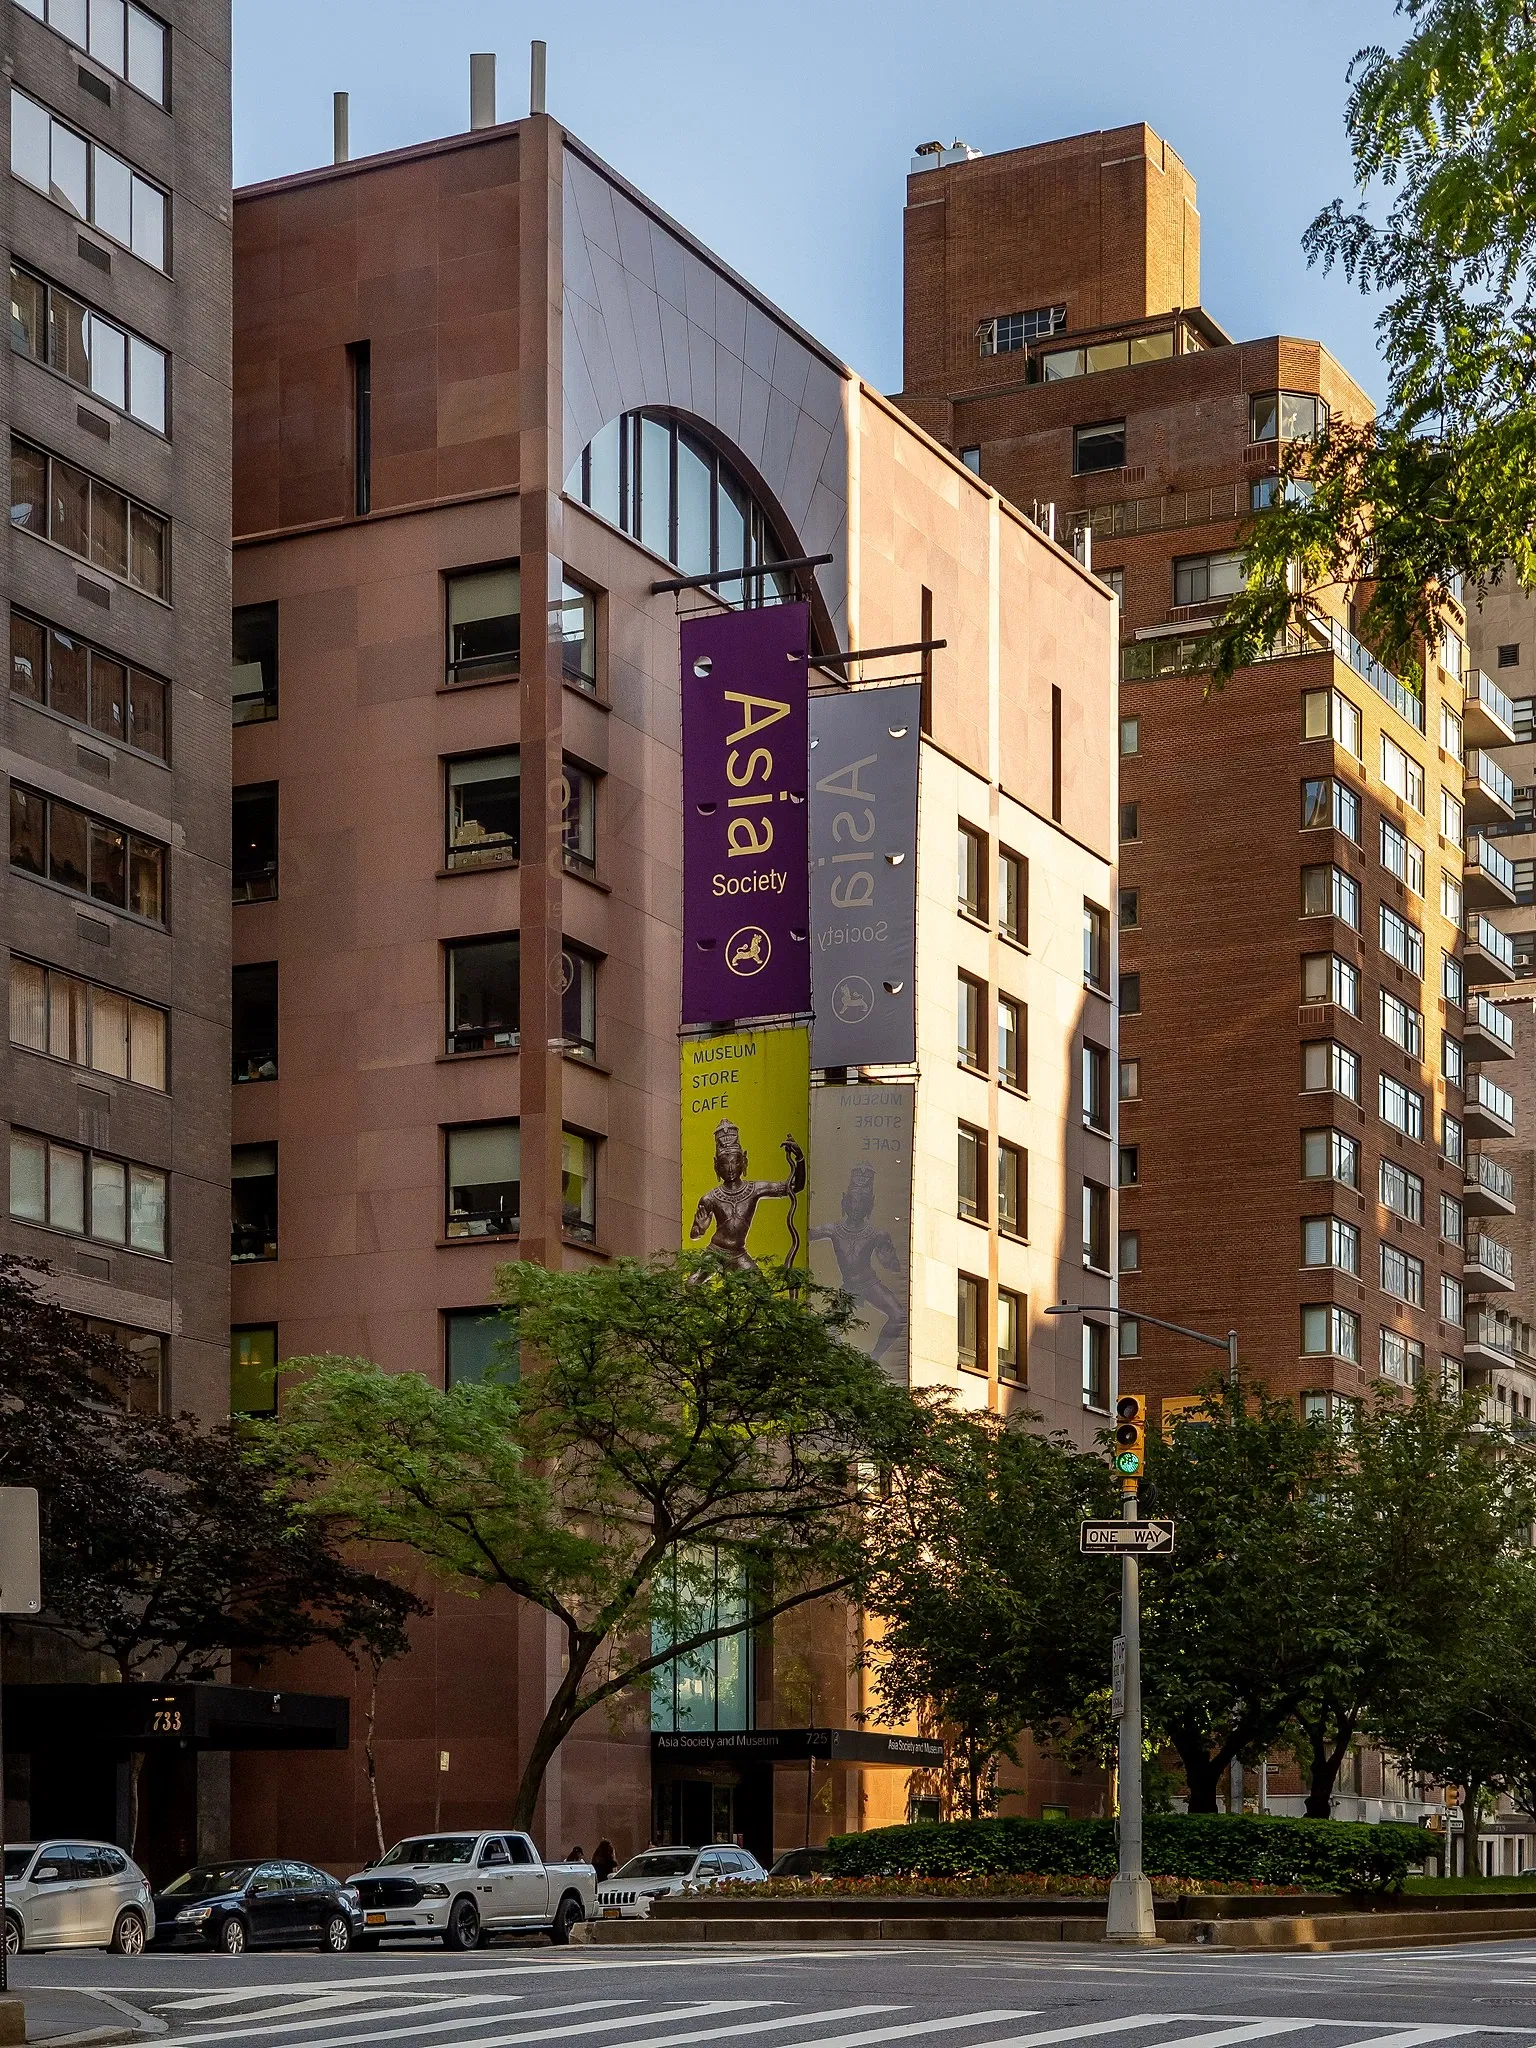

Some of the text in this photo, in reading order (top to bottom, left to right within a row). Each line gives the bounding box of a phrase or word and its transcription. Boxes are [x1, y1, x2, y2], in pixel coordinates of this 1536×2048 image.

[724, 690, 791, 858] Asia
[712, 868, 788, 898] Society
[692, 1042, 757, 1065] MUSEUM
[691, 1069, 740, 1090] STORE
[691, 1090, 730, 1114] CAFÉ
[1089, 1530, 1163, 1543] ONE WAY
[1113, 1641, 1125, 1662] STOP
[153, 1711, 182, 1731] 733
[658, 1735, 779, 1749] Asia Society and Museum
[806, 1732, 828, 1745] 725
[888, 1739, 943, 1754] Asia Society and Museum
